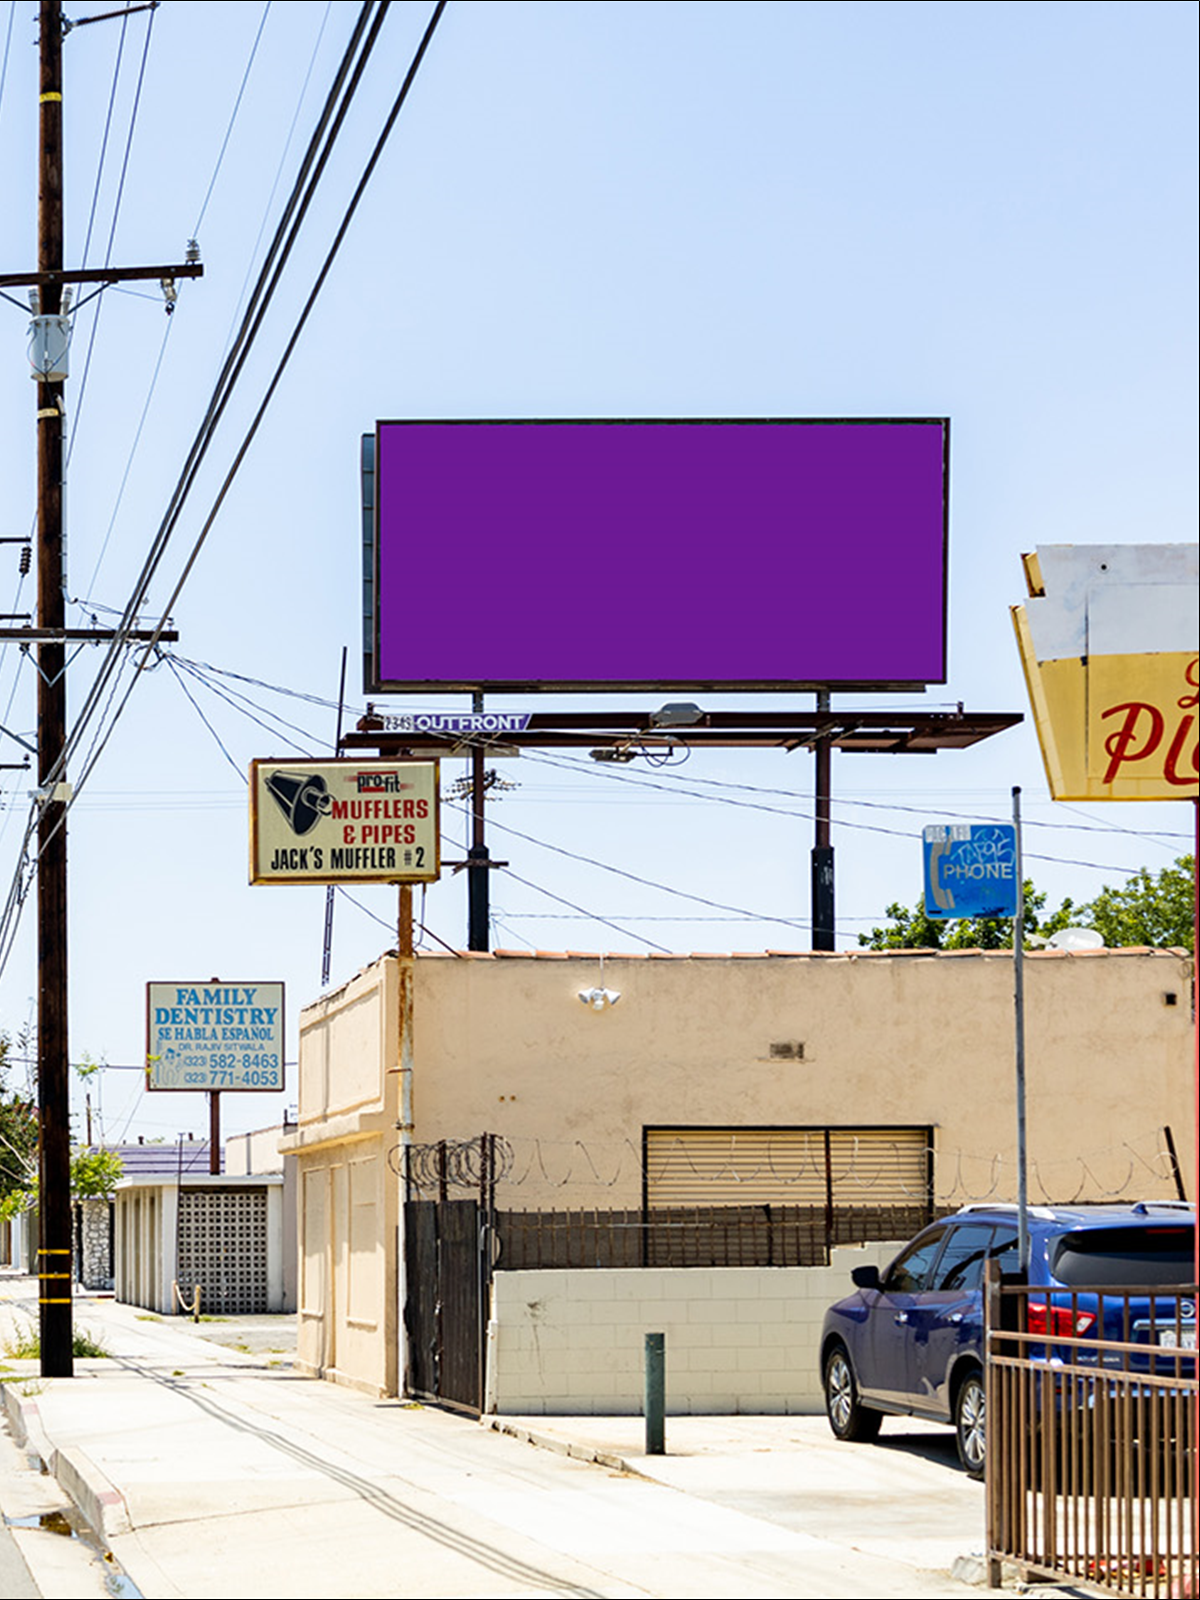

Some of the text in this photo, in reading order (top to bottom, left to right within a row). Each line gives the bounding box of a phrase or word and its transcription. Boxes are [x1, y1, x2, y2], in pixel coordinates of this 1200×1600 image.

[416, 715, 525, 730] OUTFRONT
[332, 799, 429, 820] MUFFLERS
[343, 824, 416, 844] & PIPES
[271, 846, 323, 870] JACK'S
[331, 847, 396, 869] MUFFLER
[944, 863, 1013, 879] PHONE
[176, 988, 257, 1005] FAMILY
[155, 1008, 278, 1025] DENTISTRY
[158, 1025, 274, 1041] SE HABLA ESPAÑOL
[209, 1053, 279, 1069] 582-8463
[209, 1071, 279, 1086] 771-4053
